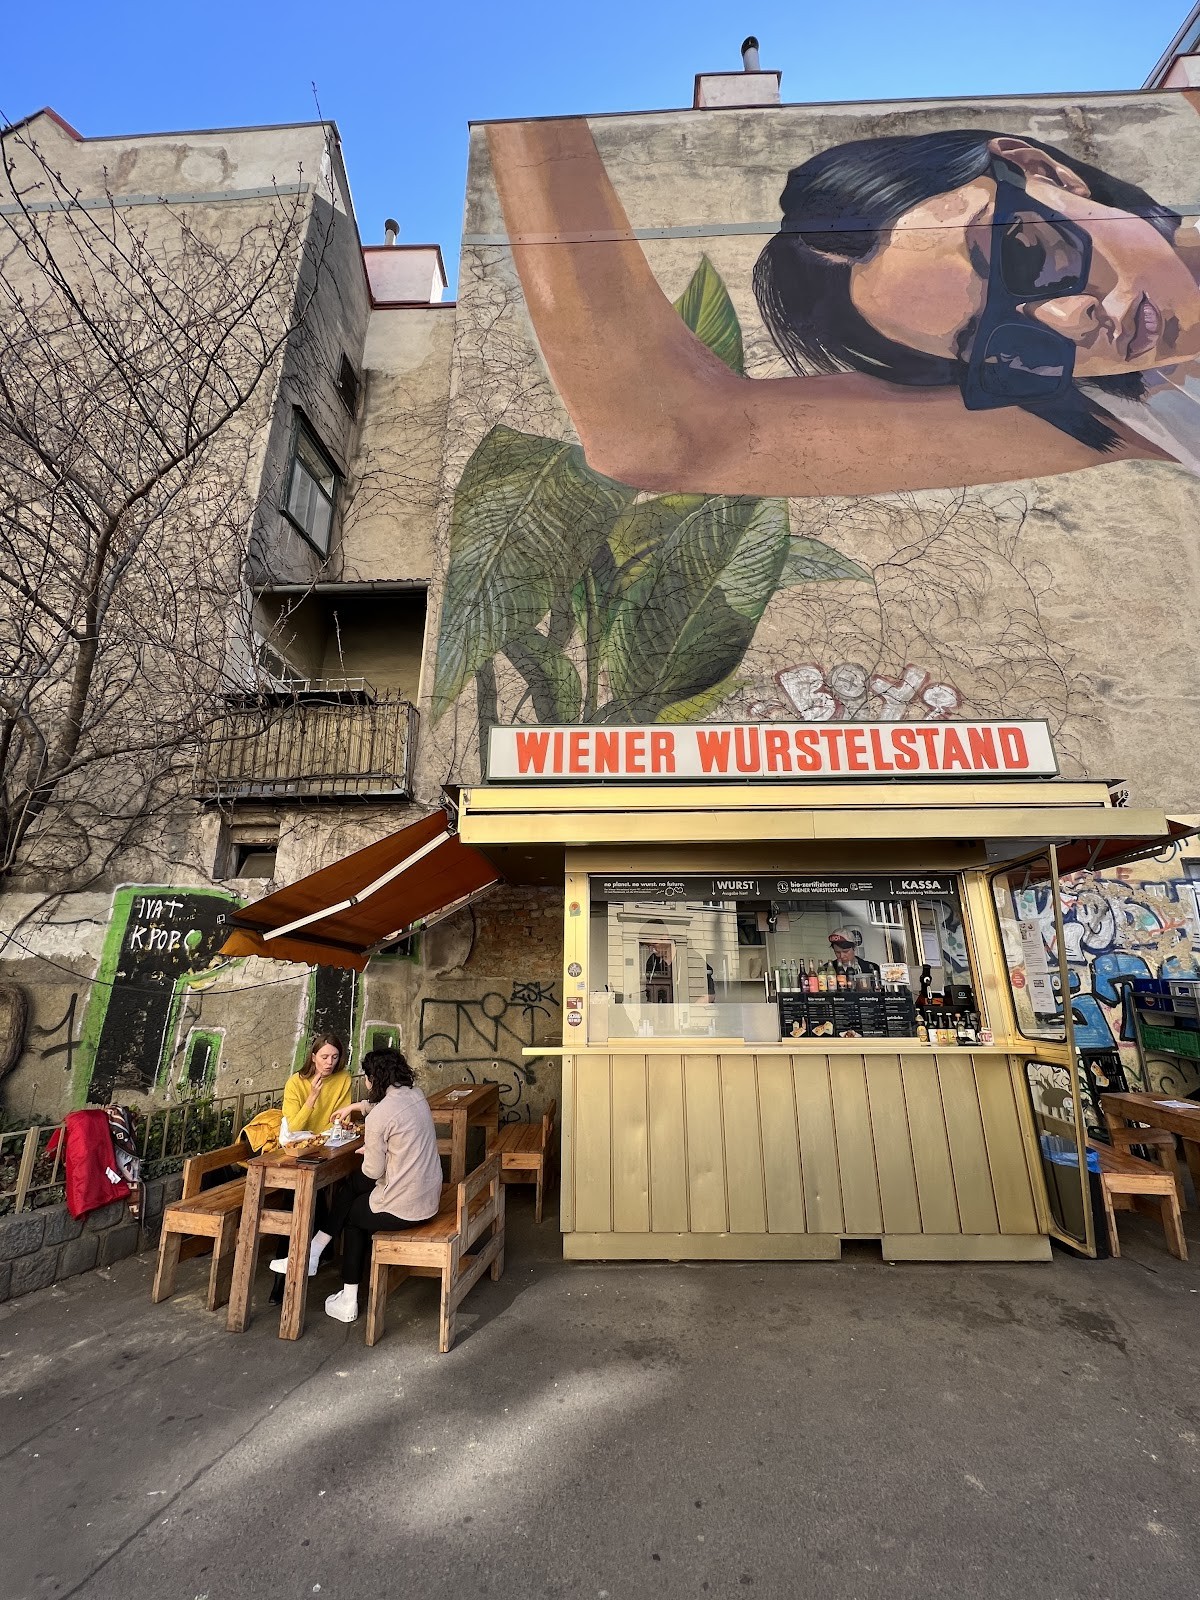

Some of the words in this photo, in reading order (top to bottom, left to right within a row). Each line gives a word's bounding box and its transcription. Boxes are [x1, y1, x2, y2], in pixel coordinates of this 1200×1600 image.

[516, 731, 676, 773] WIENER
[696, 727, 1029, 773] WÜRSTELSTAND
[716, 881, 754, 890] WURST
[901, 880, 941, 889] KASSA
